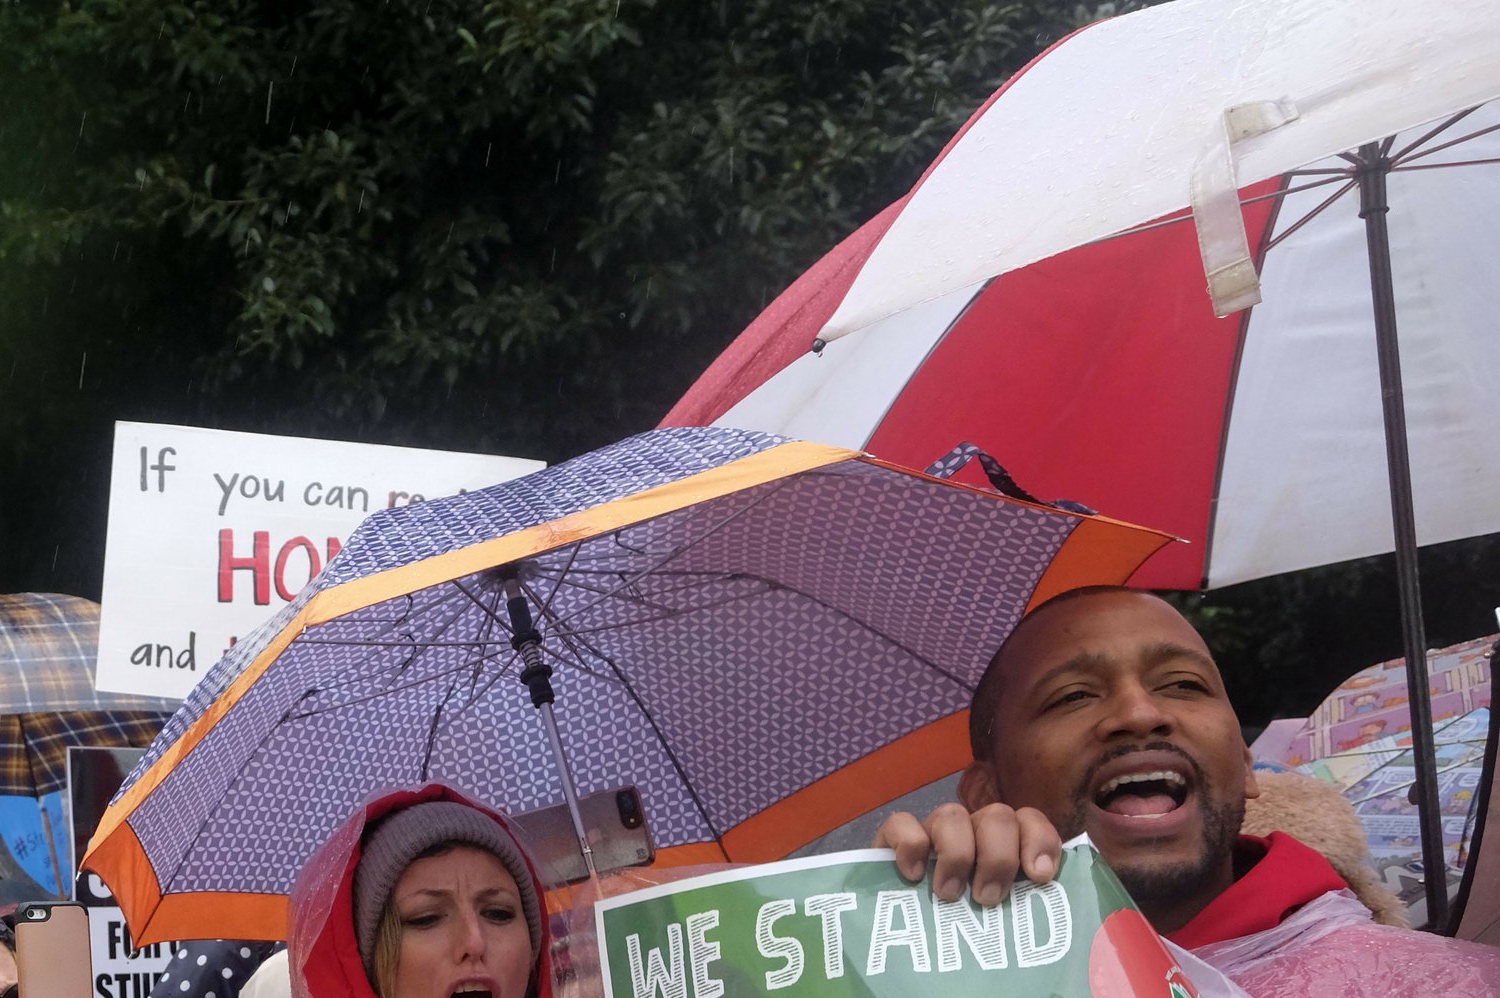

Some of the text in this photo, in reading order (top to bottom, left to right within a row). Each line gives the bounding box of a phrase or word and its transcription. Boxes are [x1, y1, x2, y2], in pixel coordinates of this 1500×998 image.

[139, 446, 178, 492] If
[213, 472, 285, 516] you
[303, 481, 369, 512] can
[130, 631, 196, 671] and
[754, 880, 1073, 991] STAND
